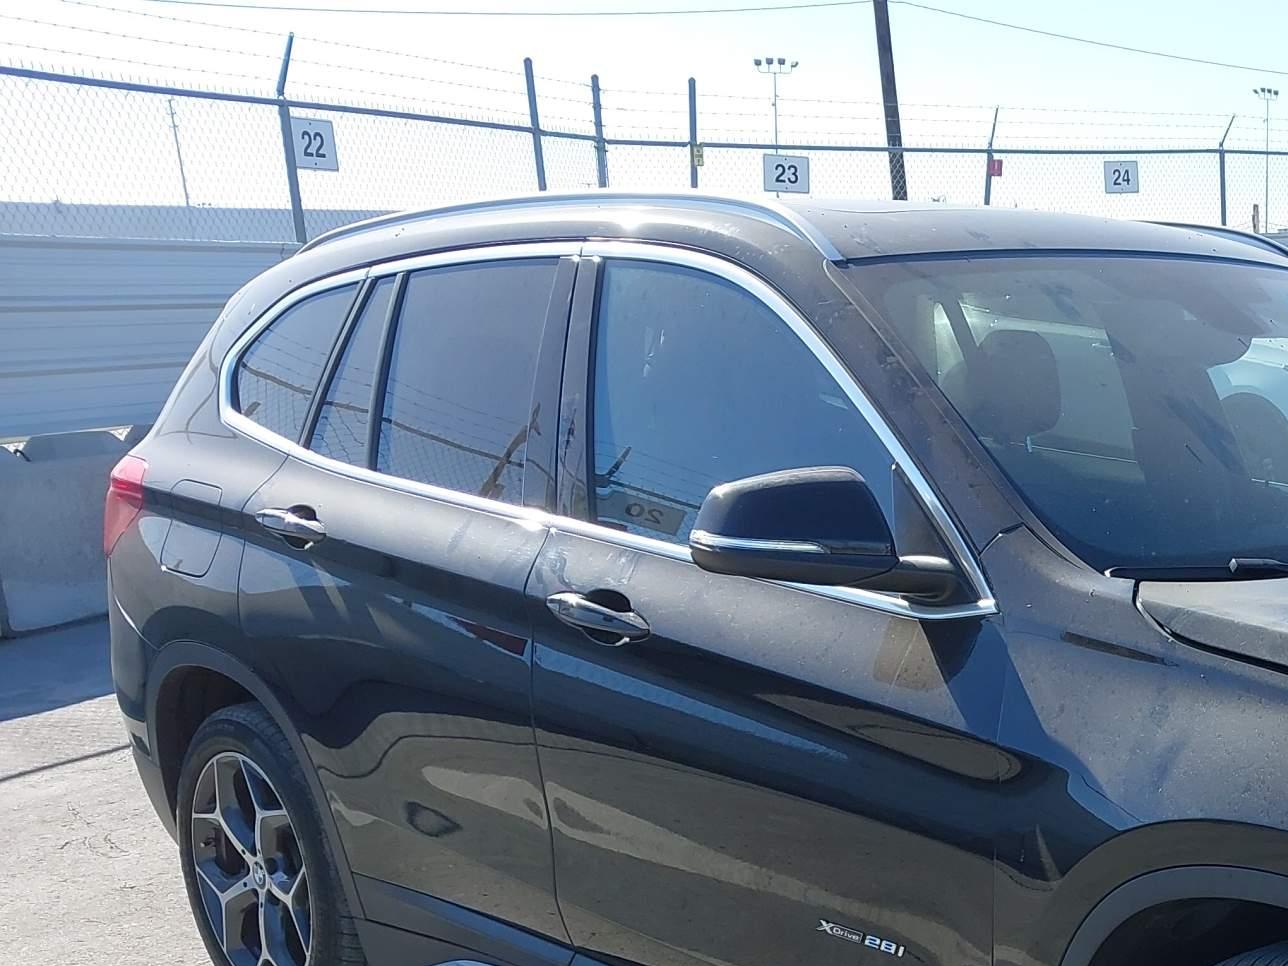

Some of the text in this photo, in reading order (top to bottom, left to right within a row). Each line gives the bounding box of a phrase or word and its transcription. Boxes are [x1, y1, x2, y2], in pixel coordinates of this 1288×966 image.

[301, 130, 326, 159] 22
[775, 163, 799, 184] 23
[1112, 168, 1131, 186] 24
